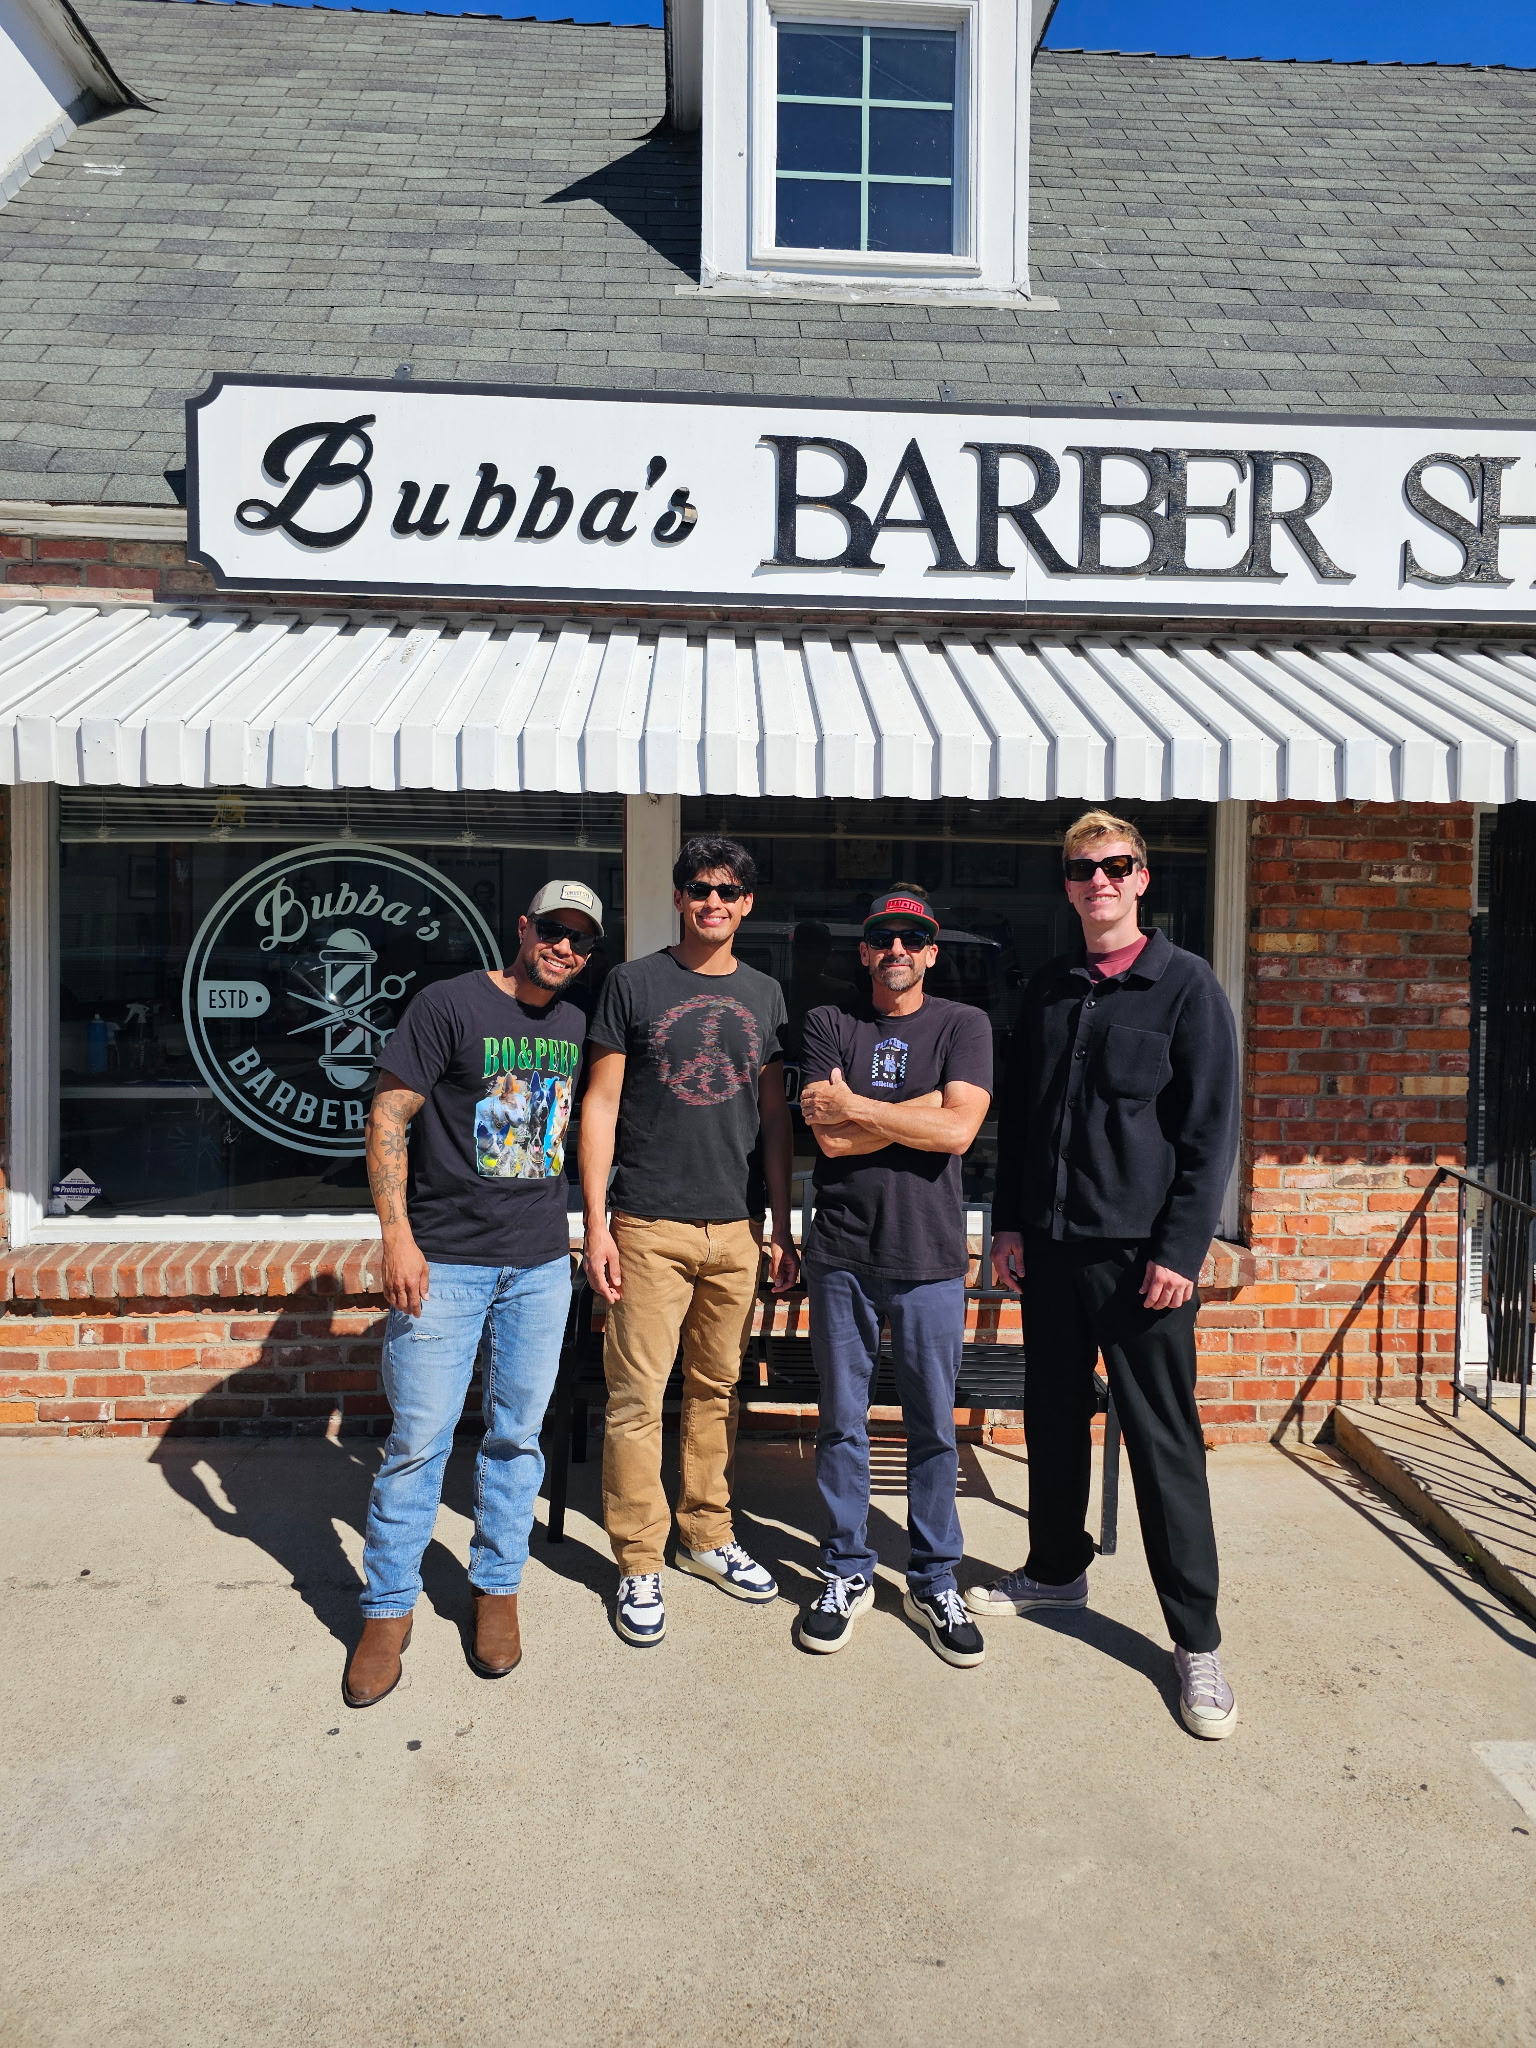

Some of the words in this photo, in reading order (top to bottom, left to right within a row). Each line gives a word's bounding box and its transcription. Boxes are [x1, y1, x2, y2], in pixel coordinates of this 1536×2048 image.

[235, 414, 698, 548] Bubba's
[760, 434, 1356, 580] BARBER
[254, 877, 441, 951] Bubba's
[208, 989, 249, 1009] ESTD
[227, 1045, 365, 1130] BARBER
[60, 1185, 90, 1194] Protection
[90, 1186, 102, 1194] One
